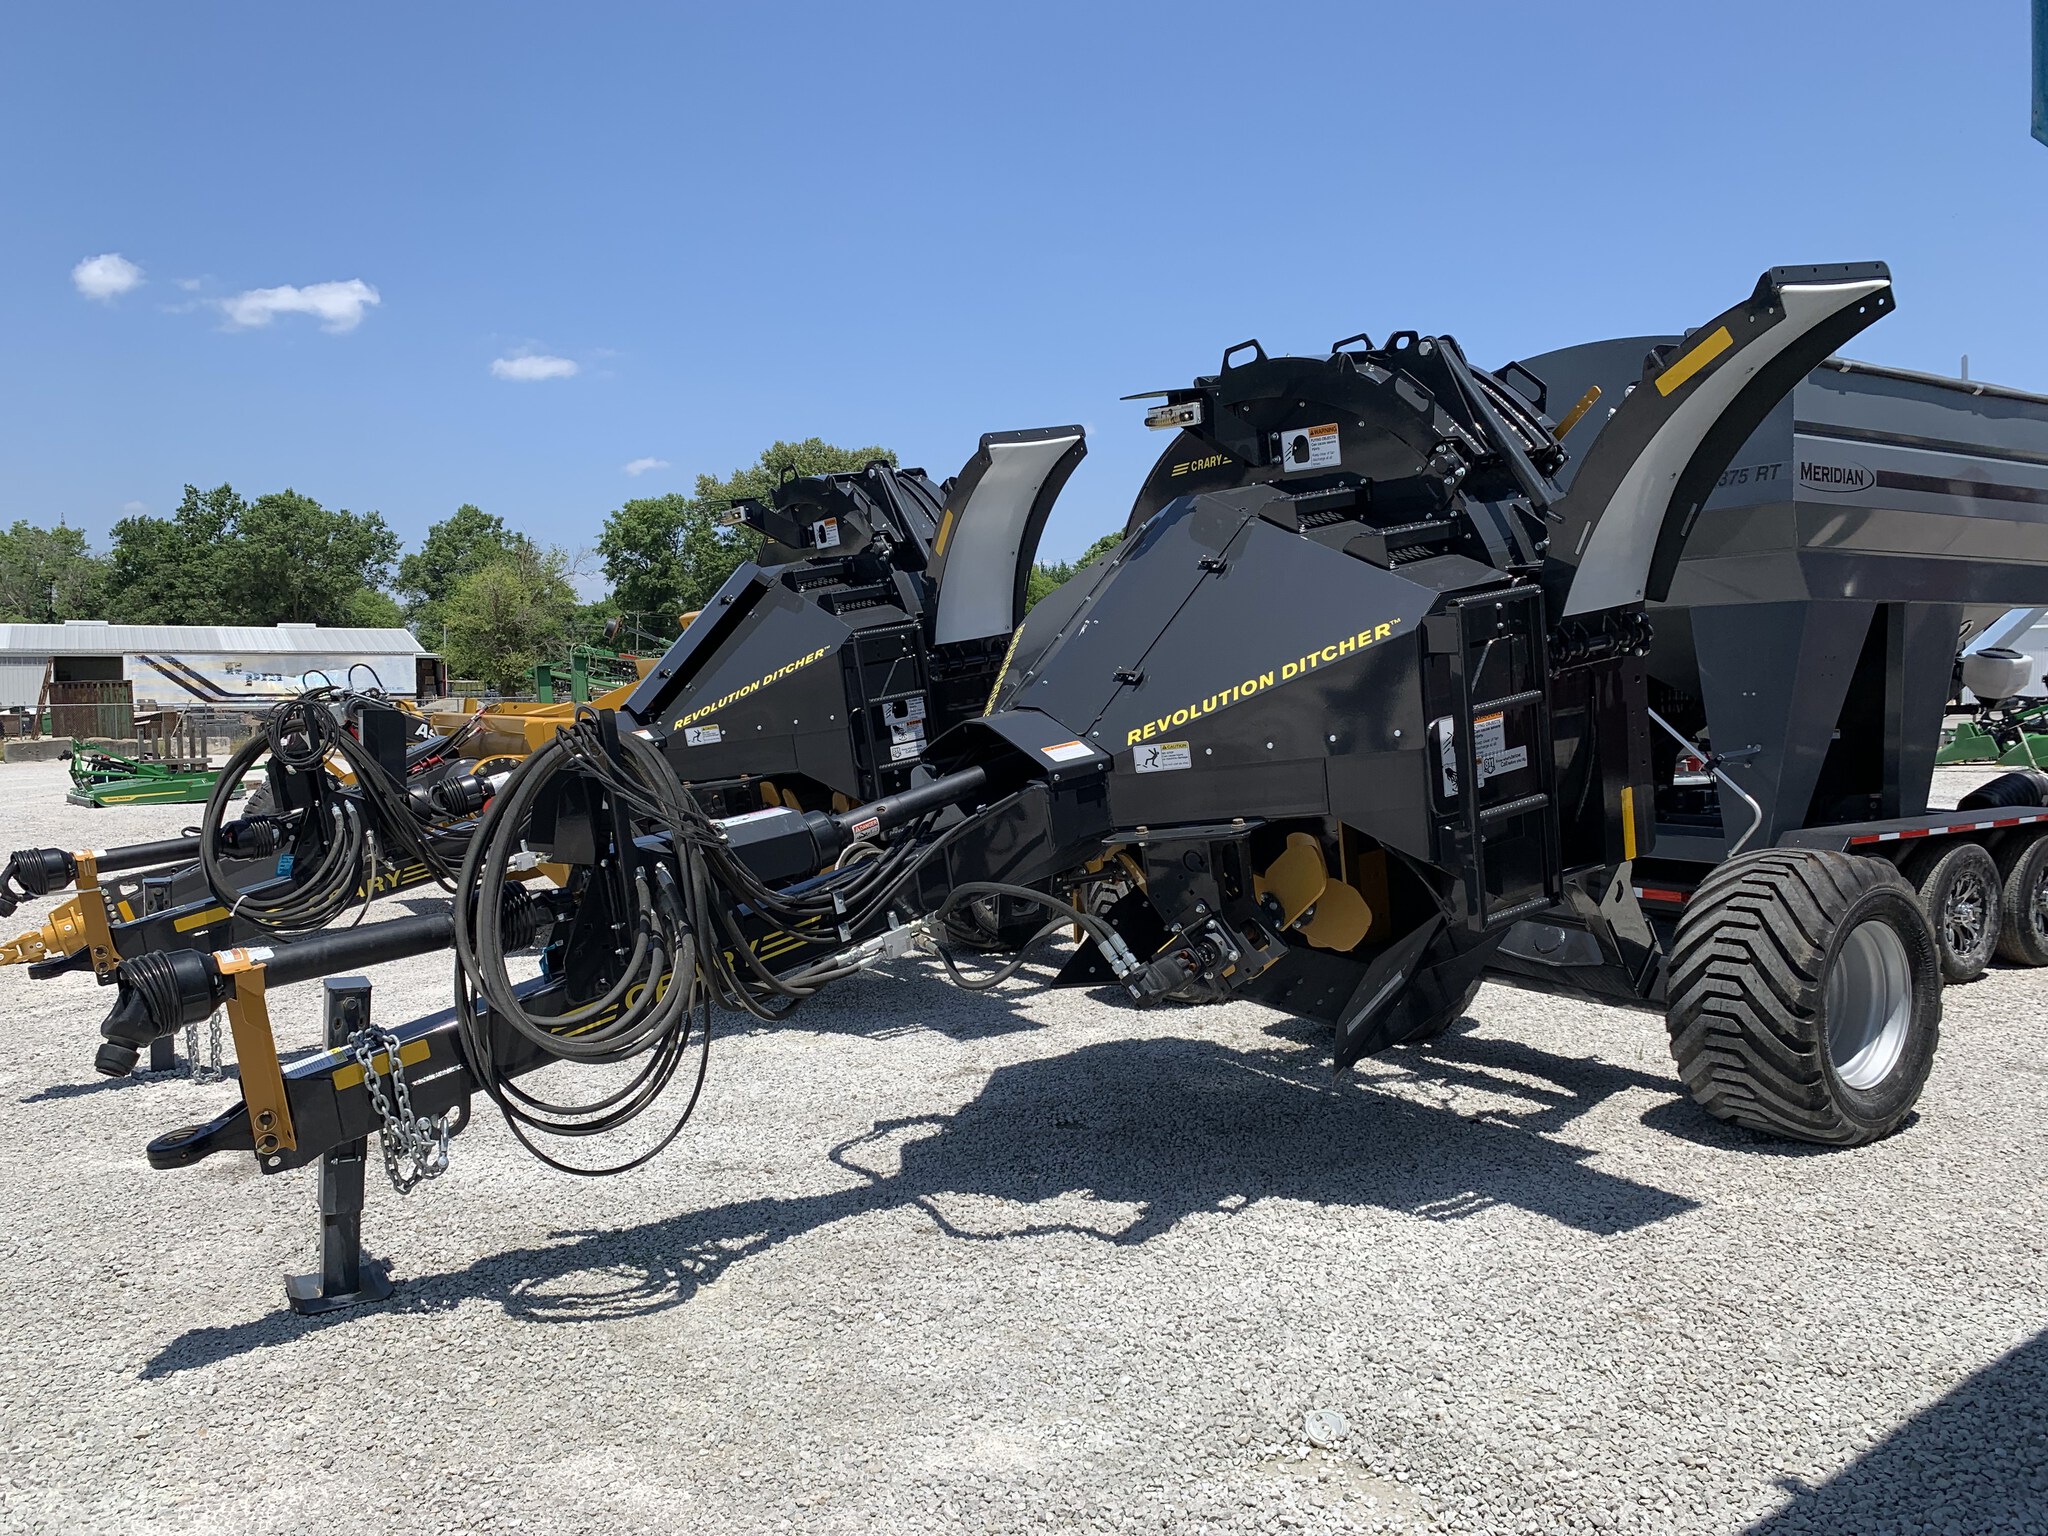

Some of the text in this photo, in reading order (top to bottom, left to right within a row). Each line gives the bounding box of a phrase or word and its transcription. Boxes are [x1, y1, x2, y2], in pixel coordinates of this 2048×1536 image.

[1191, 454, 1222, 471] CRARY
[1755, 463, 1782, 482] RT
[1800, 462, 1864, 486] MERIDIAN
[673, 680, 760, 731] REVOLUTION
[1127, 671, 1274, 746] REVOLUTION
